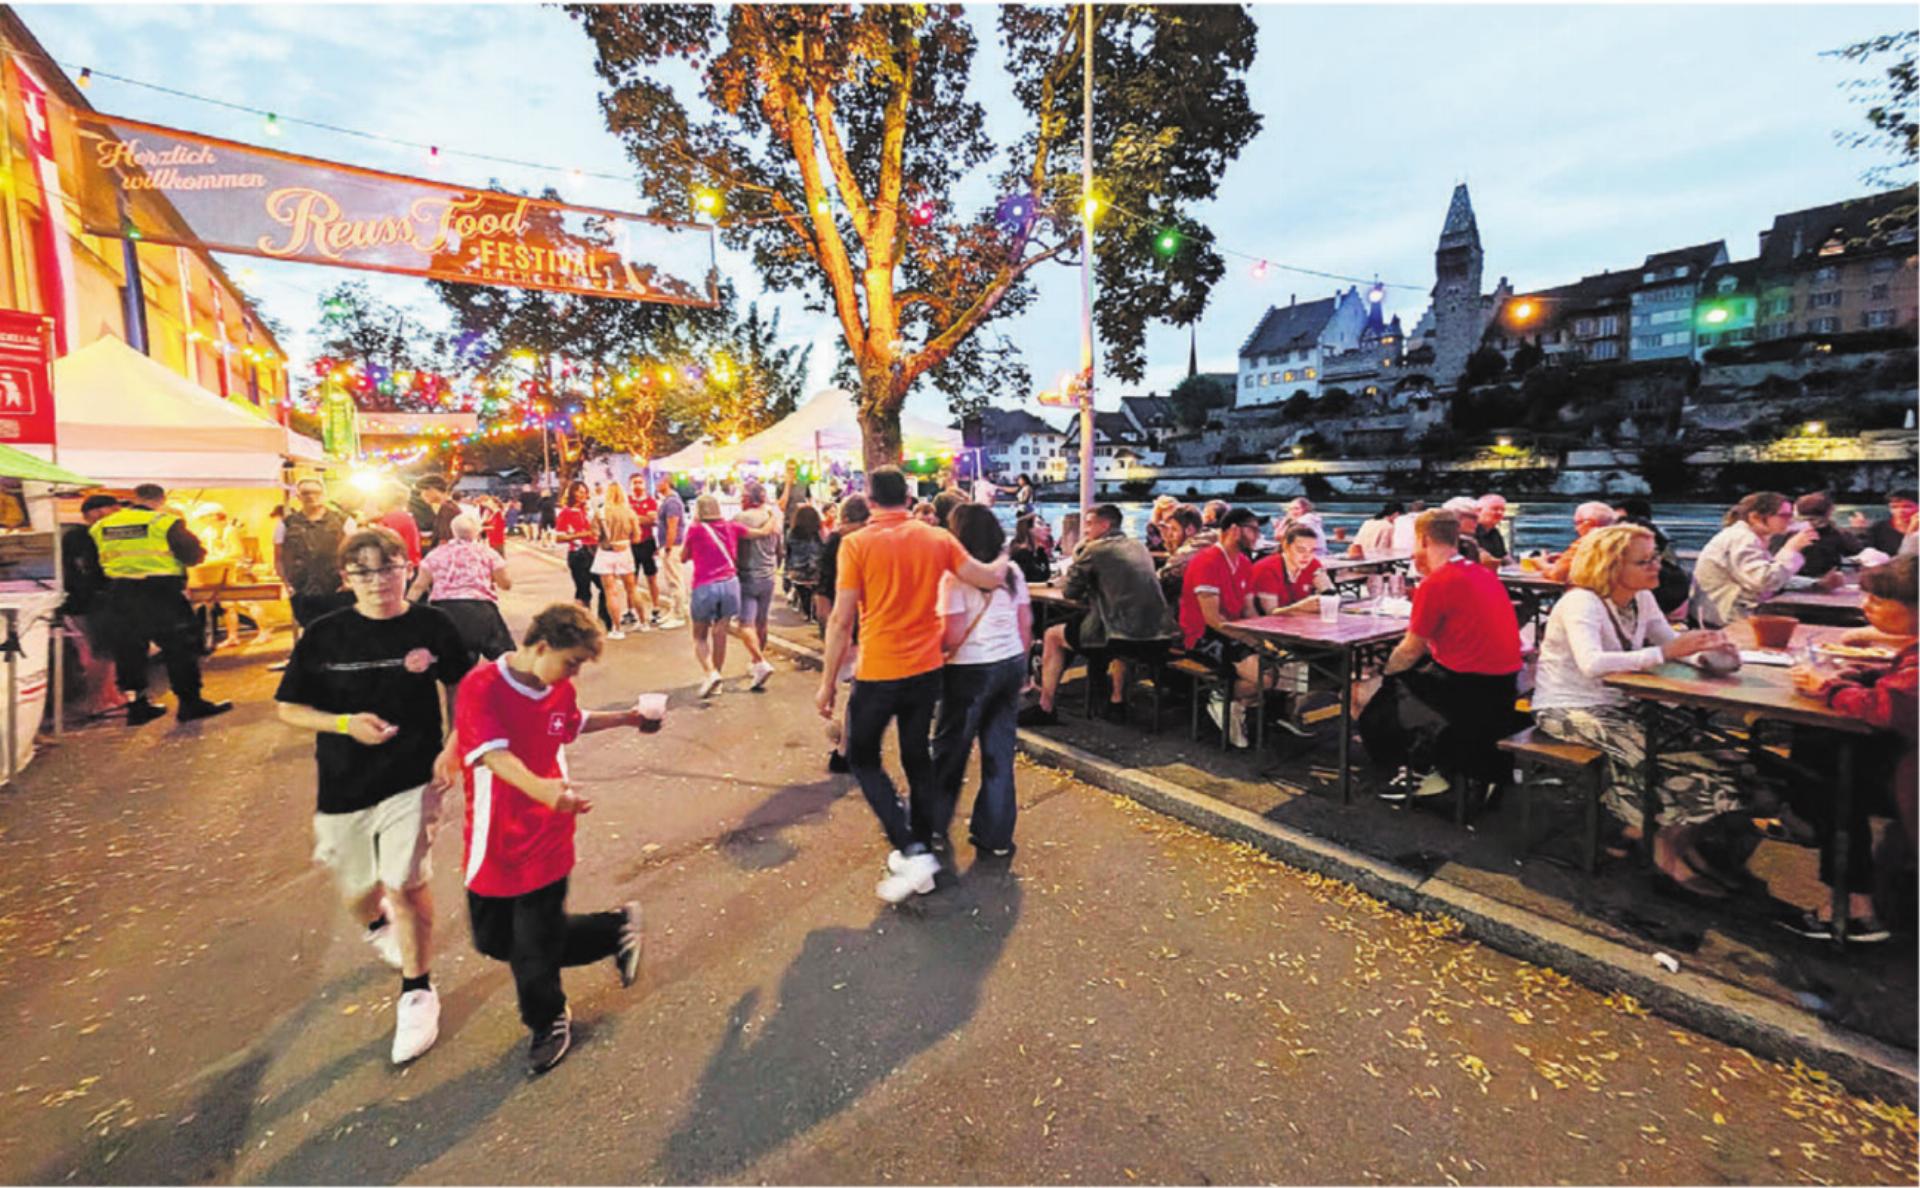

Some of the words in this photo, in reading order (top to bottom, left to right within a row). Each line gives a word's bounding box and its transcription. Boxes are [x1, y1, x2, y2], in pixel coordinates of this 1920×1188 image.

[96, 139, 217, 168] Herzlich
[121, 168, 268, 190] willkommen
[480, 239, 603, 279] FESTIVAL
